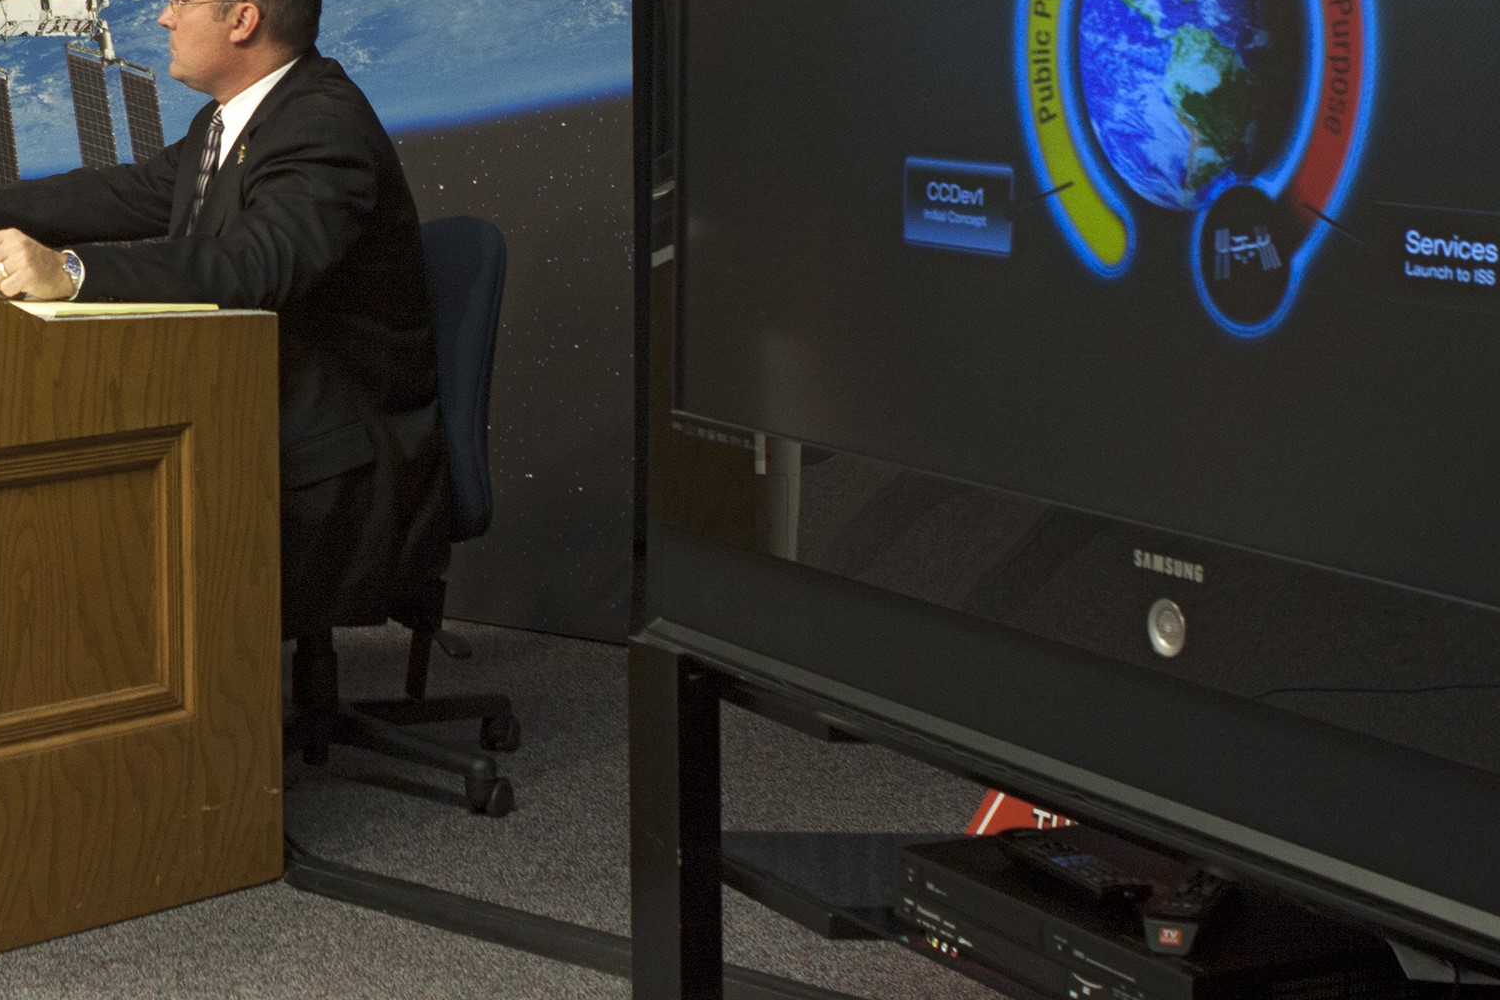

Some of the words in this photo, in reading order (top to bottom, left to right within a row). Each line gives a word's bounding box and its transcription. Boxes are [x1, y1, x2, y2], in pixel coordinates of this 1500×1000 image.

[1033, 29, 1057, 125] Public
[926, 181, 984, 206] CCDev1
[1405, 229, 1498, 263] Services
[1404, 260, 1454, 280] Launch
[1455, 267, 1471, 283] to
[1473, 268, 1496, 286] ISS
[1133, 549, 1204, 583] SAMSUNG
